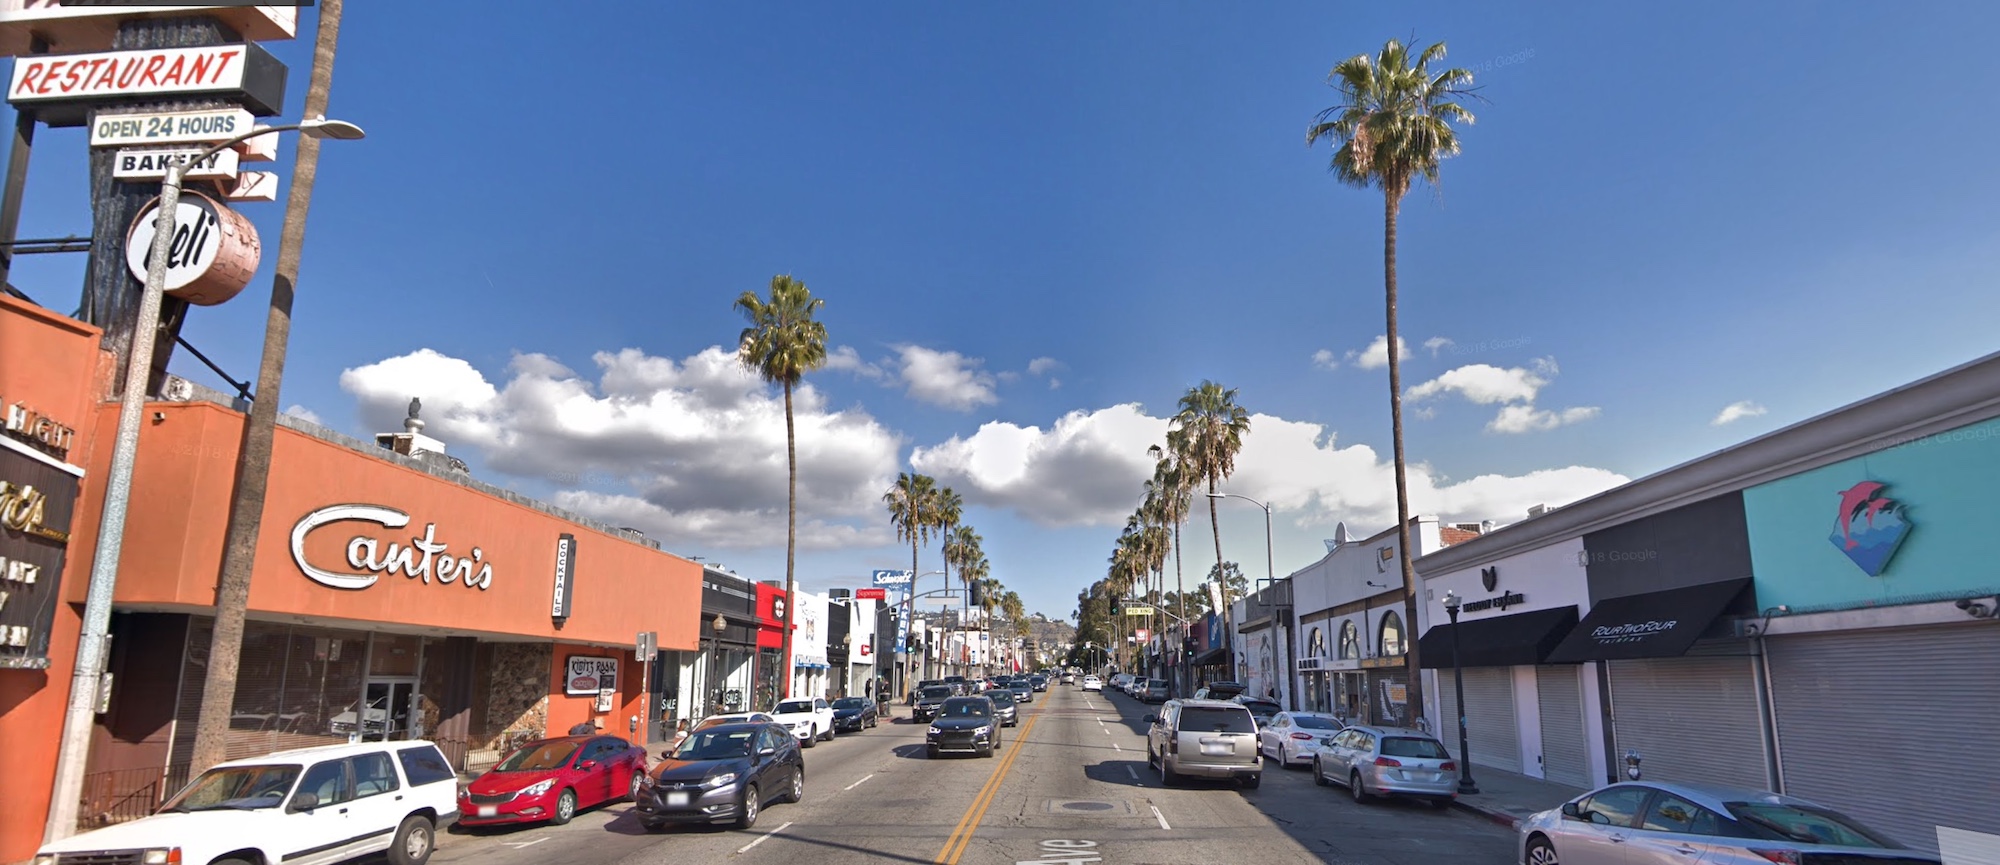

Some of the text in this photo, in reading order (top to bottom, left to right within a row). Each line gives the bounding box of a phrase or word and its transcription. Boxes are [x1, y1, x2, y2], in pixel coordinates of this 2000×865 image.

[16, 51, 240, 95] RESTAURANT
[98, 115, 236, 138] OPEN 24 HOURS
[289, 503, 493, 591] Canter's
[554, 543, 567, 613] COCKTAILS
[897, 592, 910, 647] BAKERY
